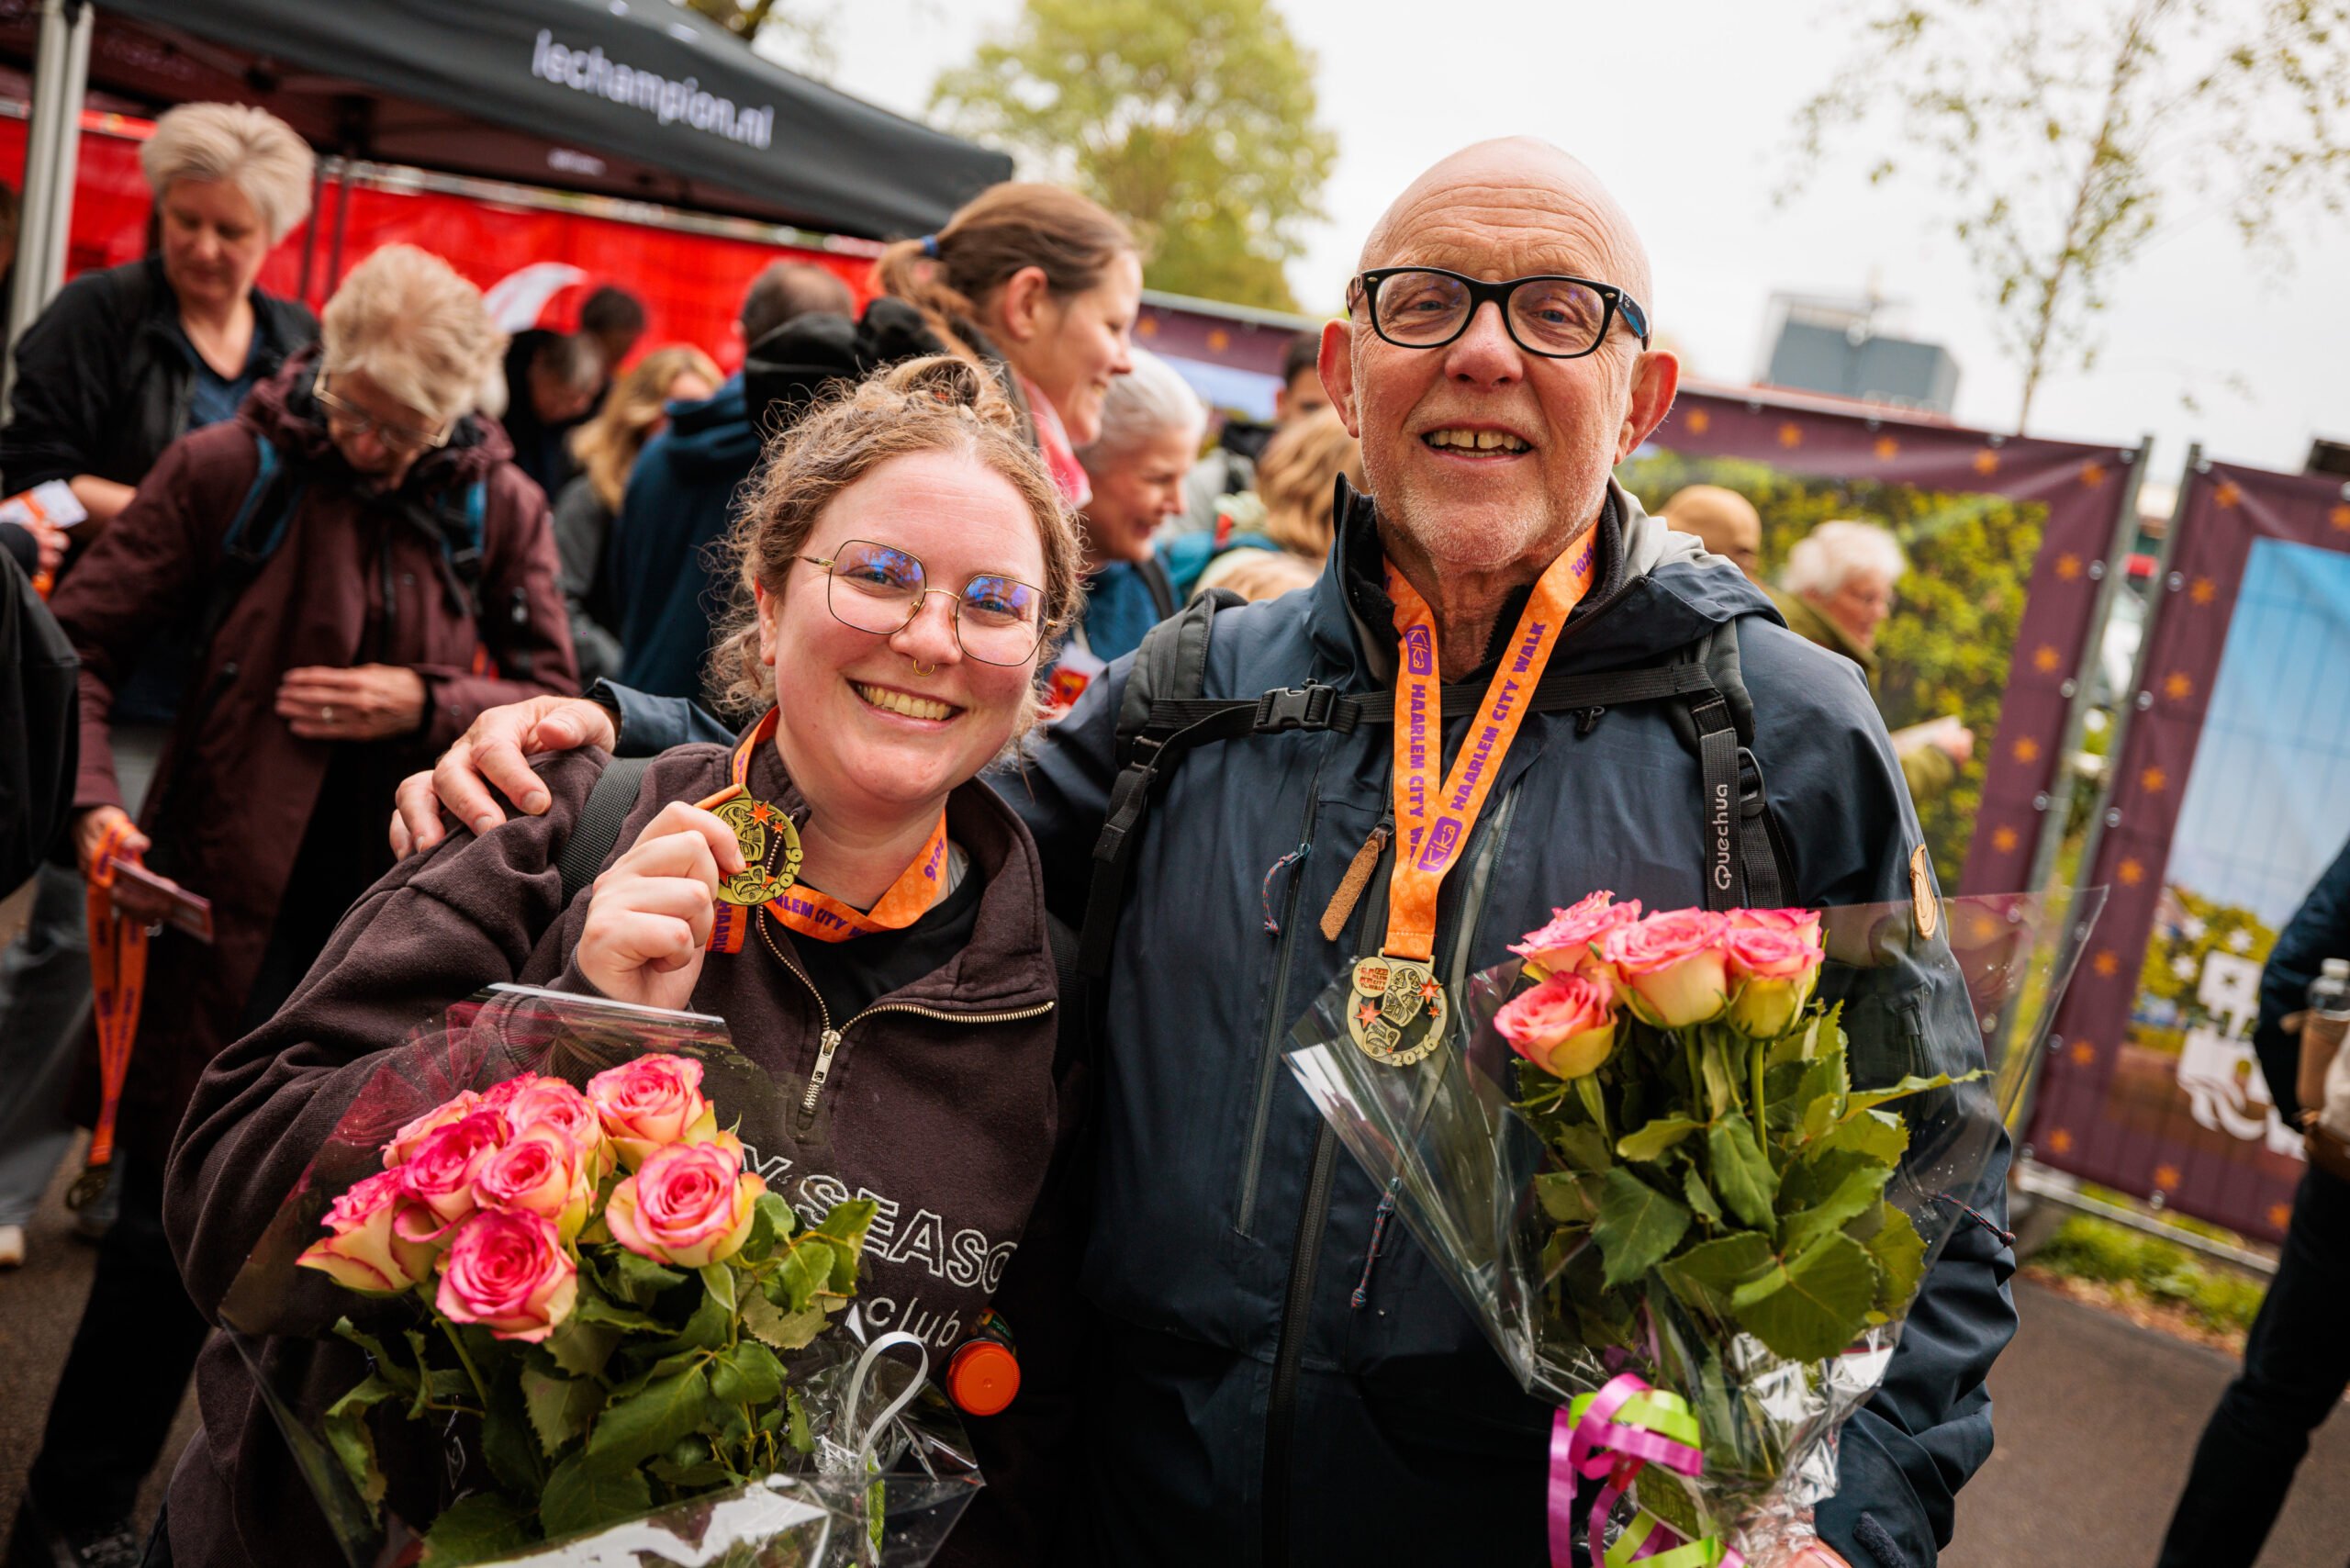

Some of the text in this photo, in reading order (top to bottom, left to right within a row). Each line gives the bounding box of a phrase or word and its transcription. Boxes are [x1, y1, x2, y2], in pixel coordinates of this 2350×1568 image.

[532, 28, 774, 150] lechampion.nl
[1450, 725, 1500, 812] HAARLEM
[1492, 678, 1519, 722] CITY
[1512, 621, 1547, 673] WALK
[1571, 542, 1594, 578] 2026
[1410, 684, 1426, 769] HAARLEM
[1409, 775, 1425, 818] CITY
[923, 837, 945, 881] 2026
[1712, 784, 1732, 890] Quechua
[769, 847, 803, 898] 2026
[775, 894, 848, 931] RLEM CITY
[1391, 1034, 1439, 1067] 2026
[794, 1174, 1017, 1294] SEASO
[866, 1296, 961, 1348] club
